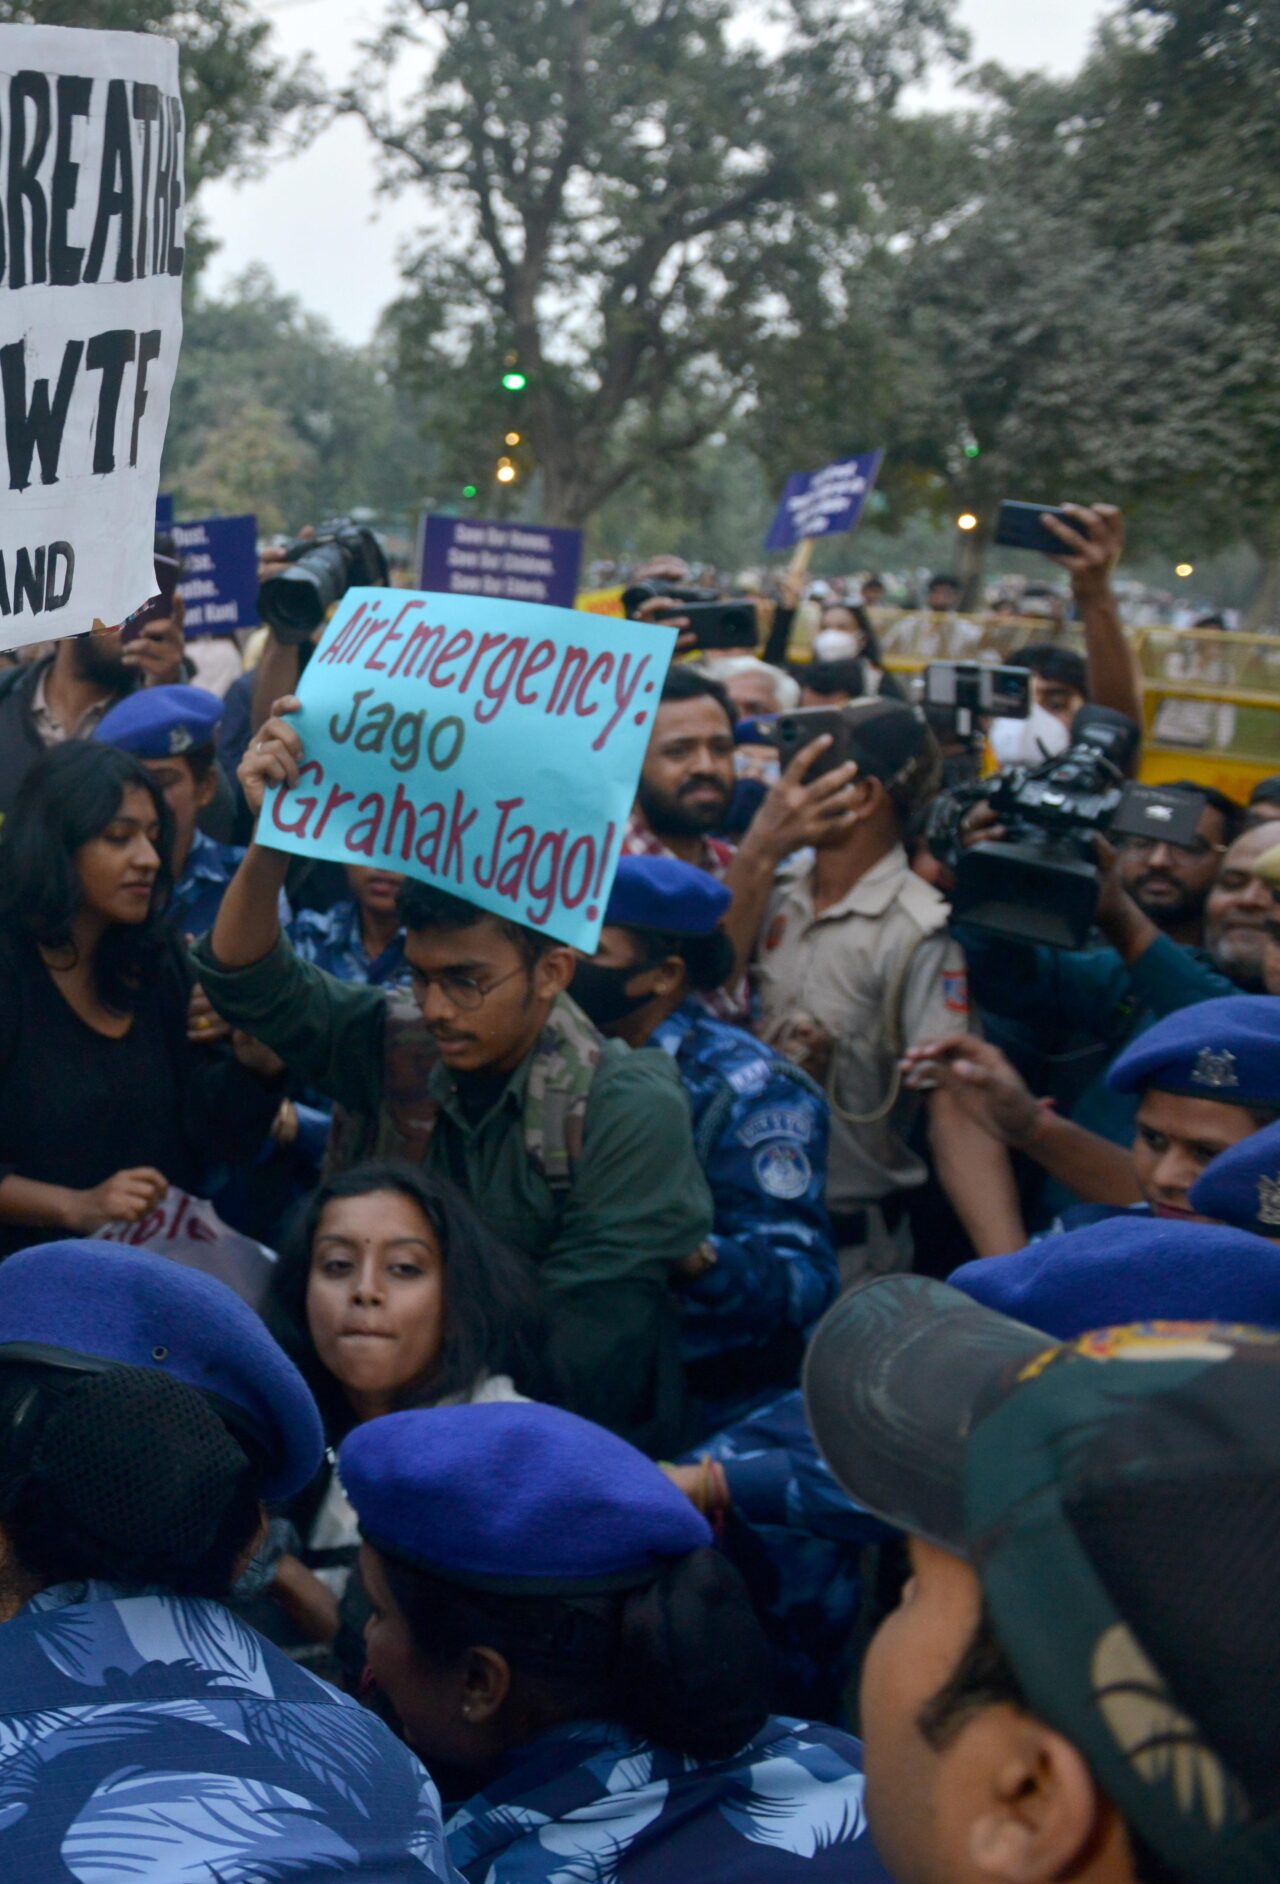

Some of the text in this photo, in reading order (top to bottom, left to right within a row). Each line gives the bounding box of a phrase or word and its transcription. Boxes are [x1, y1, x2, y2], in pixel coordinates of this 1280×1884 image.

[0, 328, 162, 493] WTF
[329, 688, 466, 772] Jago
[271, 760, 617, 926] Grahak Jago!
